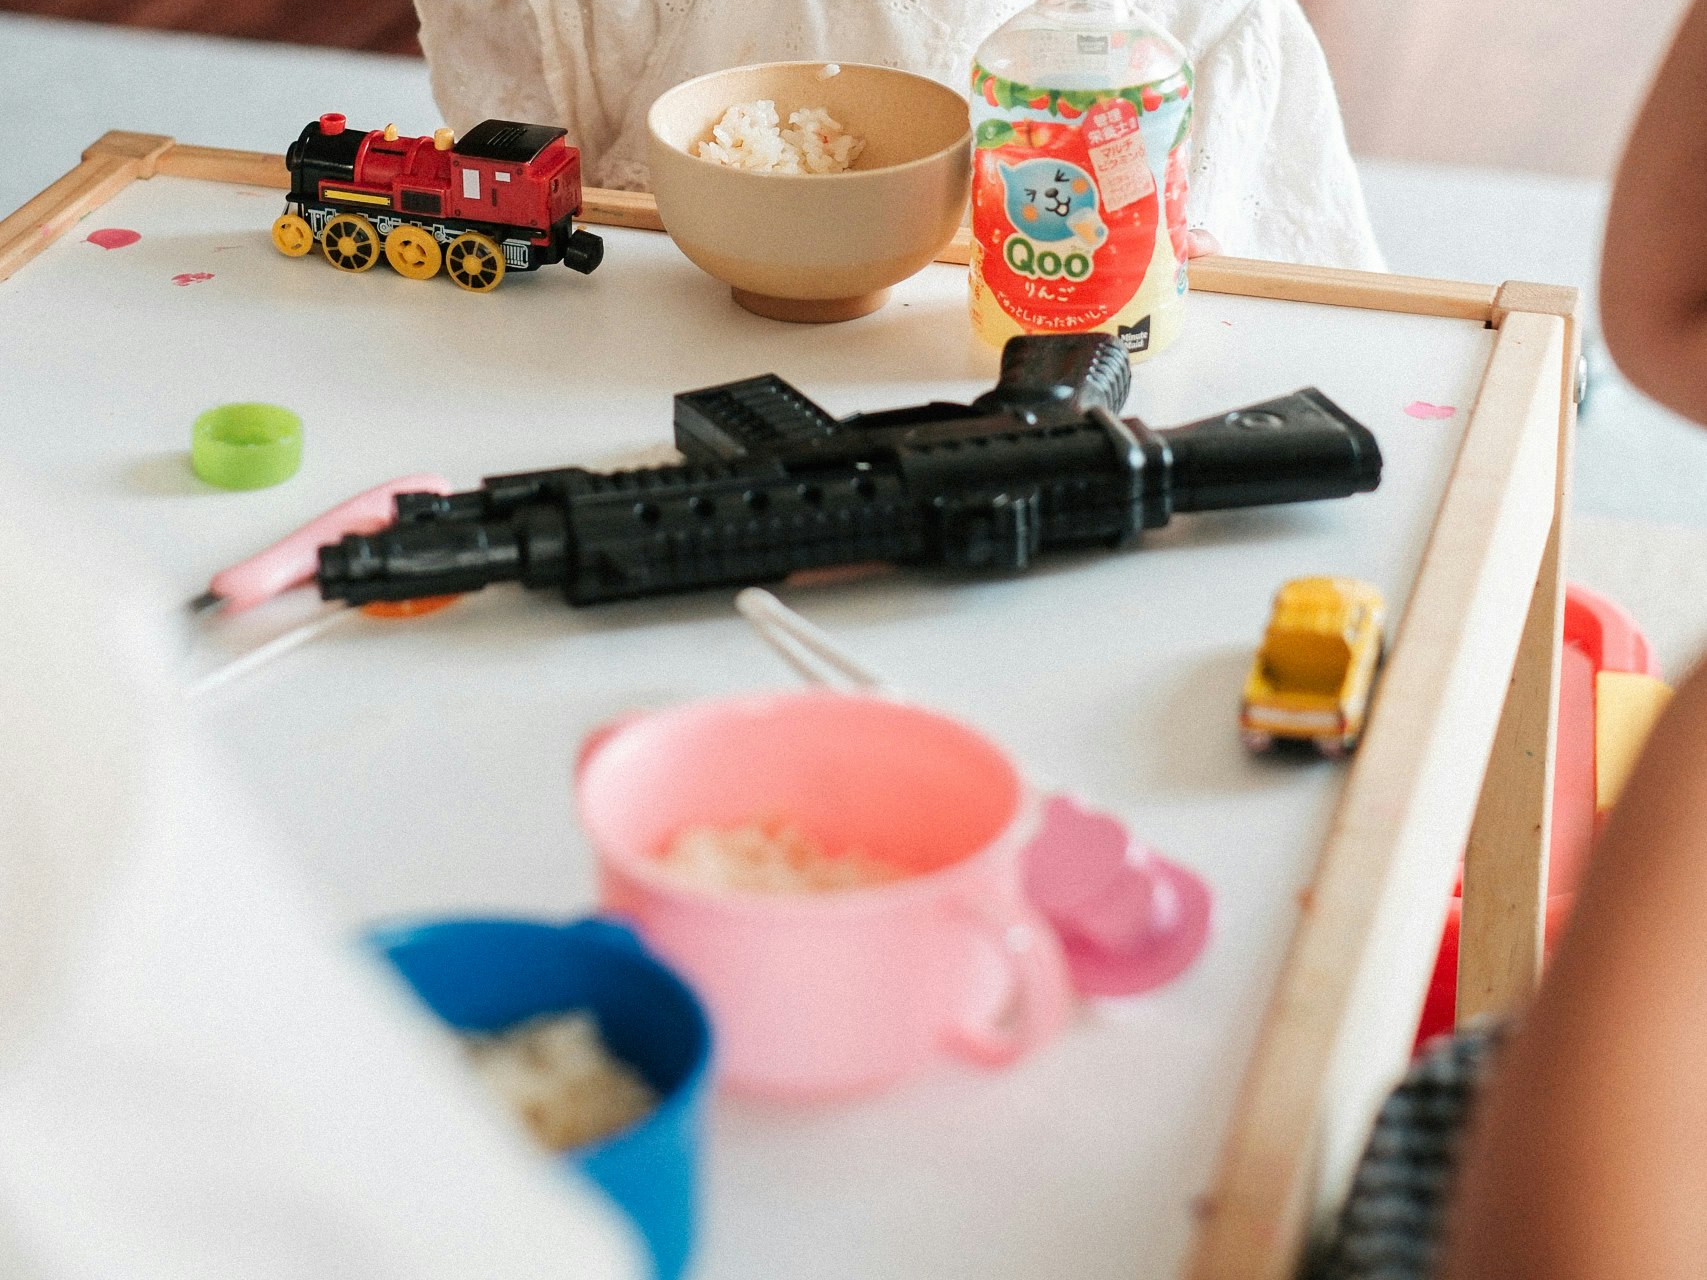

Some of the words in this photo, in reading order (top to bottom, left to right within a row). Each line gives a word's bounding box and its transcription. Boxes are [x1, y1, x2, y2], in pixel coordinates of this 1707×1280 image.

[1006, 236, 1090, 278] Qoo
[1025, 281, 1076, 302] りんご
[1120, 330, 1149, 342] Minute
